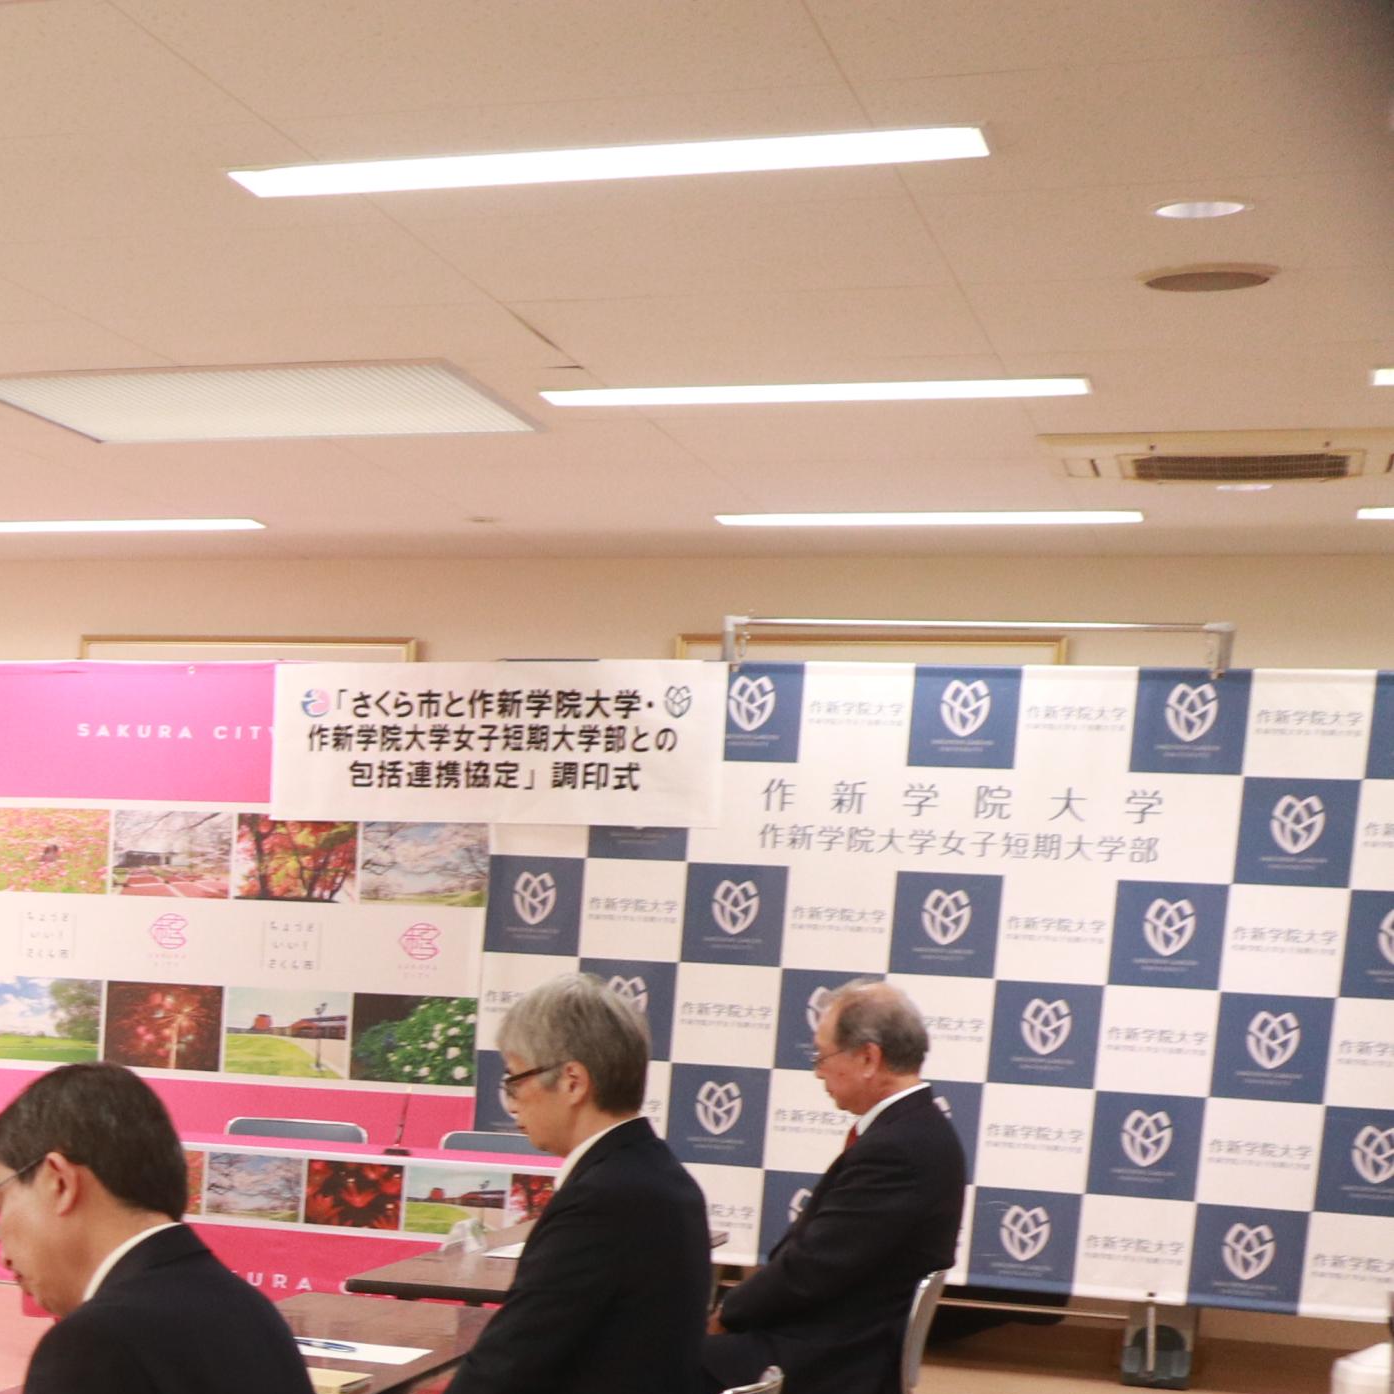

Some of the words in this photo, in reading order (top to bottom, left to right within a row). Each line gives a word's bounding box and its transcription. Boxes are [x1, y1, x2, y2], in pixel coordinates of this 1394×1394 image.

[336, 688, 655, 720] 「さくら市と作新学院大学・
[1255, 708, 1364, 726] 作新学院大学
[77, 722, 192, 740] SAKURA
[308, 723, 678, 753] 作新学院大学女子短期大学部との
[348, 760, 641, 792] 包括連携協定」調印式
[761, 777, 1164, 824] 作新学院大学
[758, 822, 1160, 865] 作新学院大学女子短期大学部
[589, 896, 678, 914] 作新学院大学
[793, 905, 887, 922] 作新学院大学
[1007, 916, 1106, 932] 作新学院大学
[1233, 925, 1339, 945] 作新学院大学
[681, 1000, 773, 1018] 作新学院大学
[1108, 1026, 1210, 1044] 作新学院大学
[986, 1121, 1085, 1143] 作新学院大学
[1210, 1138, 1313, 1160] 作新学院大学
[1086, 1234, 1184, 1255] 作新学院大学
